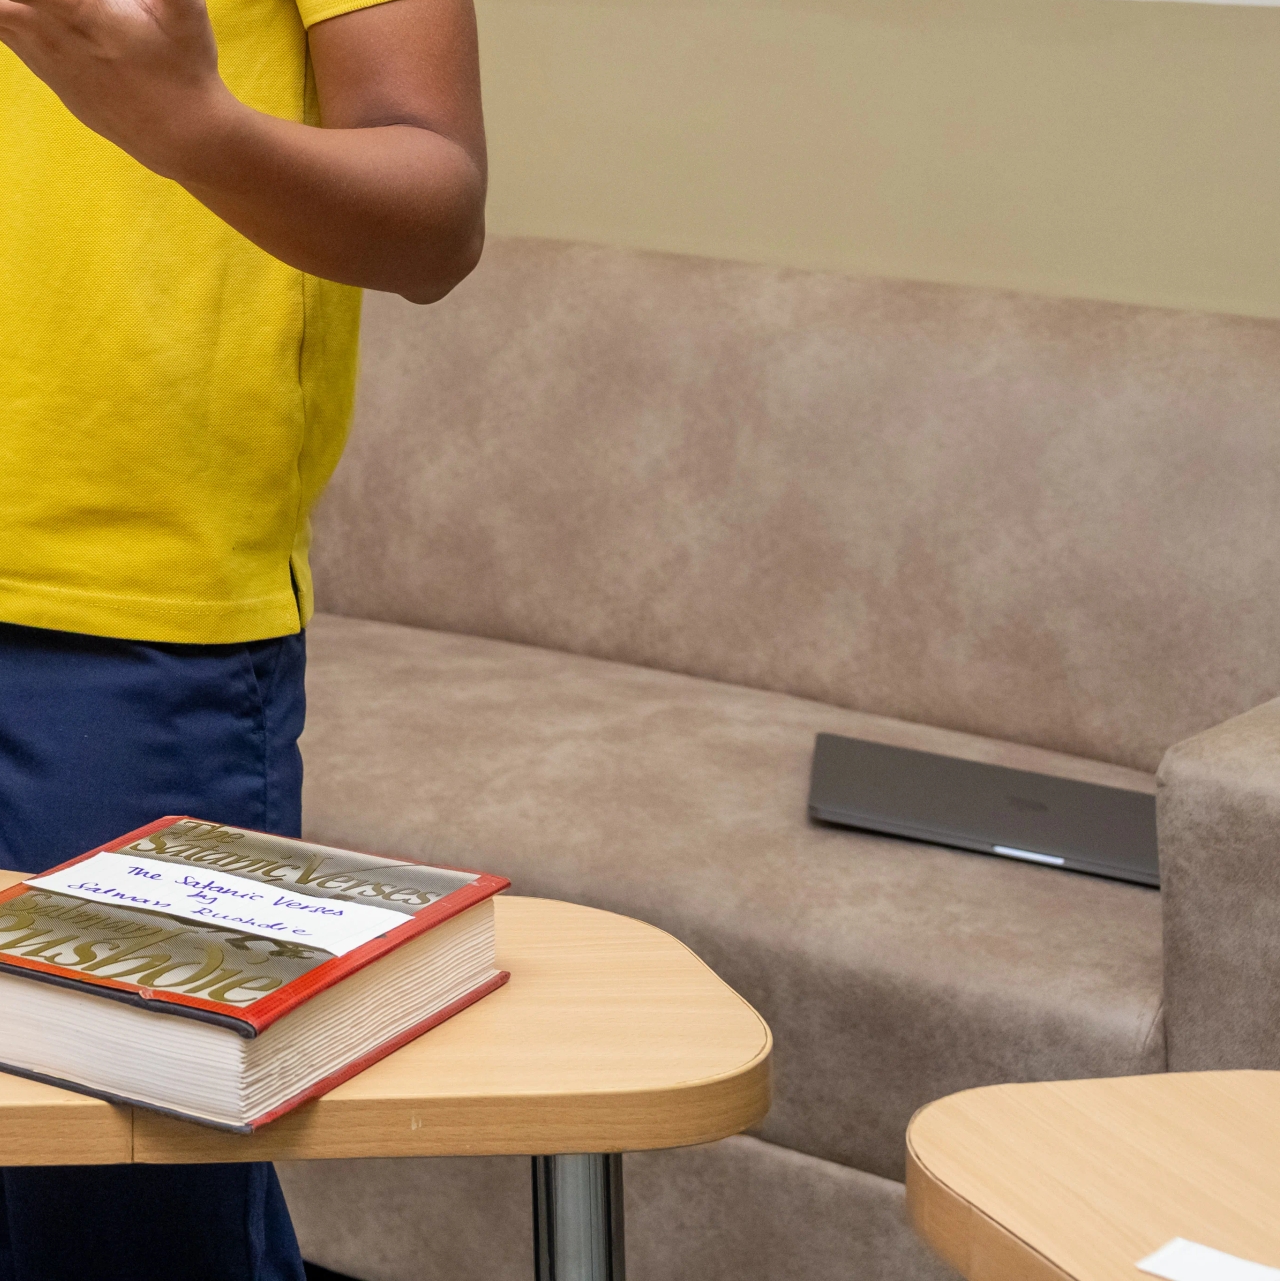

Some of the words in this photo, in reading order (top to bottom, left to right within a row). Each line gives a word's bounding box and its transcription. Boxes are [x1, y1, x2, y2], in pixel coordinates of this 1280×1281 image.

[170, 820, 245, 844] The
[129, 829, 301, 882] Satanic
[293, 852, 442, 907] Verses
[68, 881, 172, 908] Salman
[127, 865, 164, 881] The
[174, 875, 264, 902] Satanic
[273, 896, 344, 918] Verses
